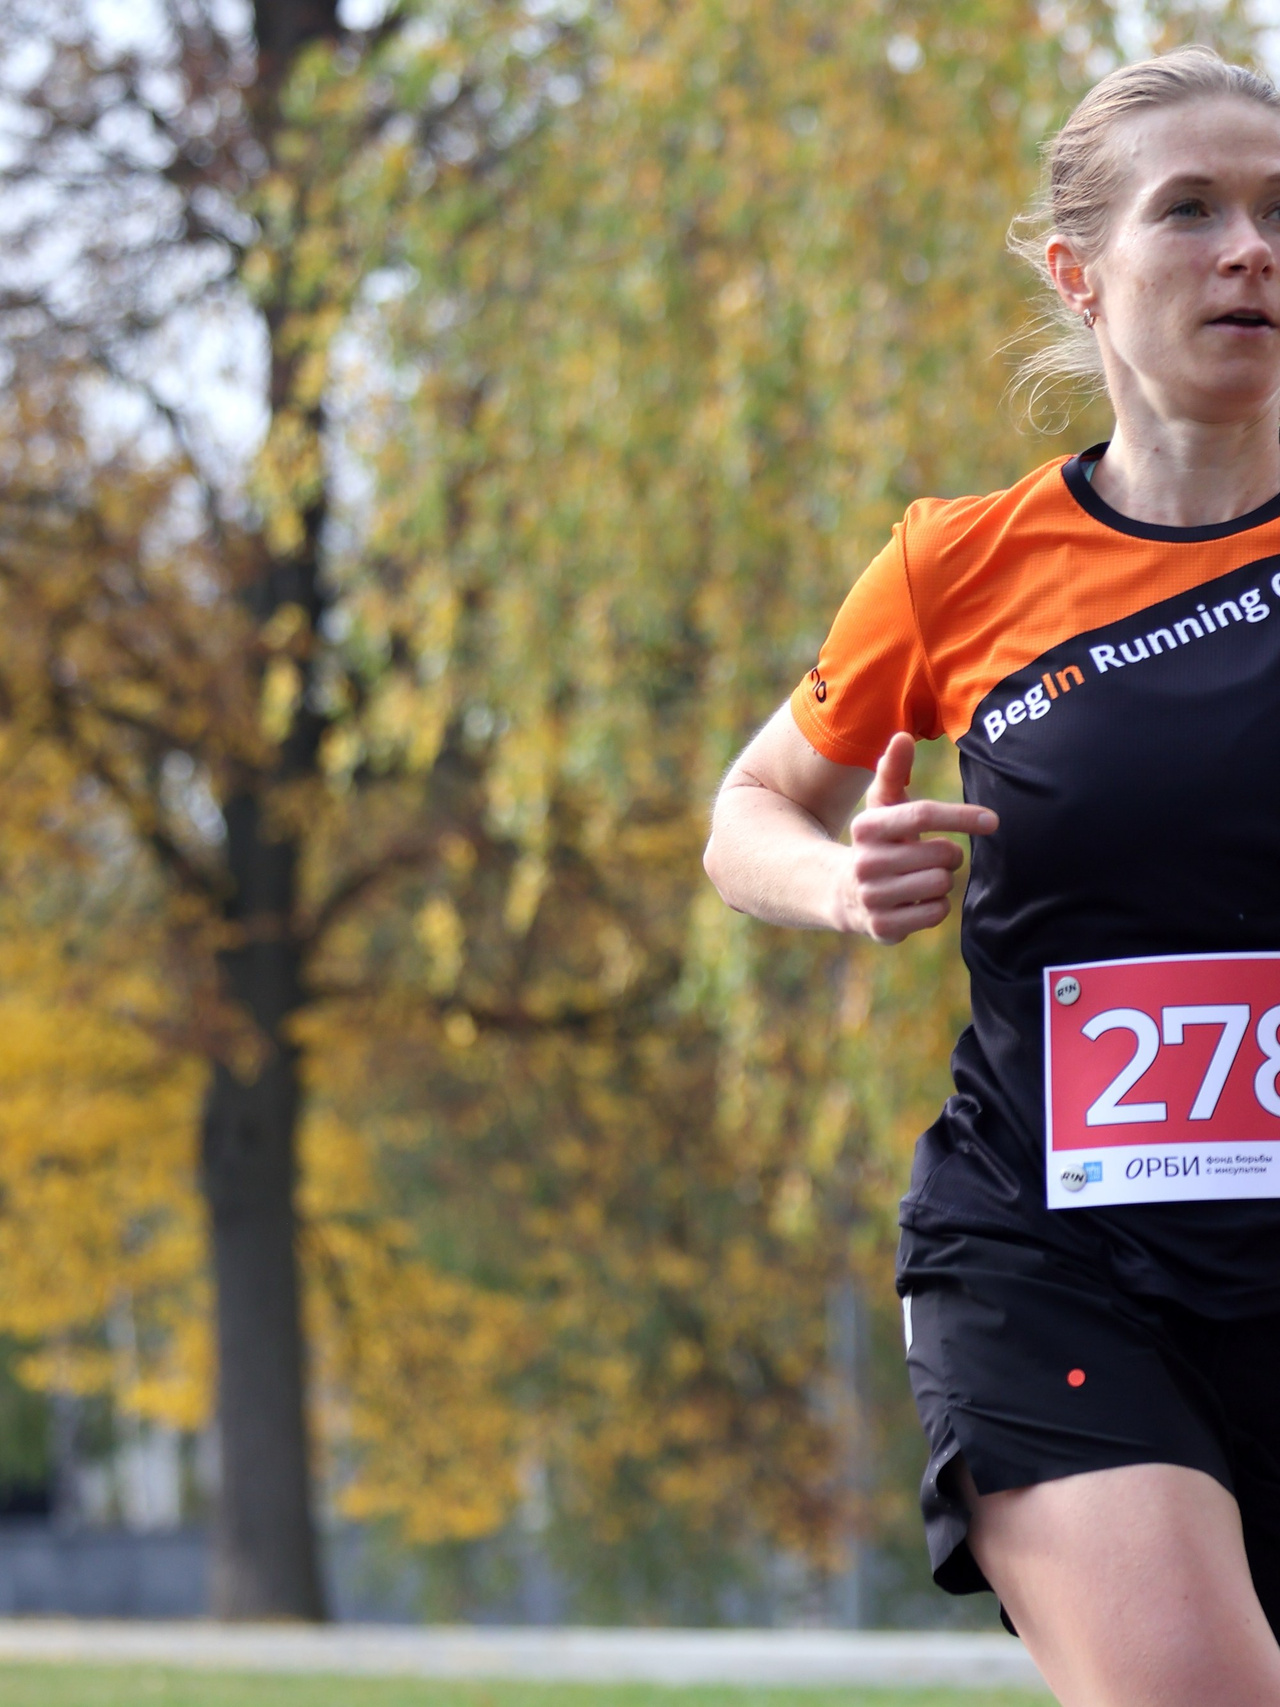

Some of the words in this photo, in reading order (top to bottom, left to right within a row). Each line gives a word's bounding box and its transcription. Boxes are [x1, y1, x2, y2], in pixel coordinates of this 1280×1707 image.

[982, 664, 1087, 744] BegIn
[1089, 587, 1271, 674] Running
[1125, 1156, 1200, 1180] ОРБИ
[1206, 1156, 1233, 1166] фонд
[1235, 1154, 1273, 1165] борьбы
[1215, 1166, 1267, 1176] инсультом
